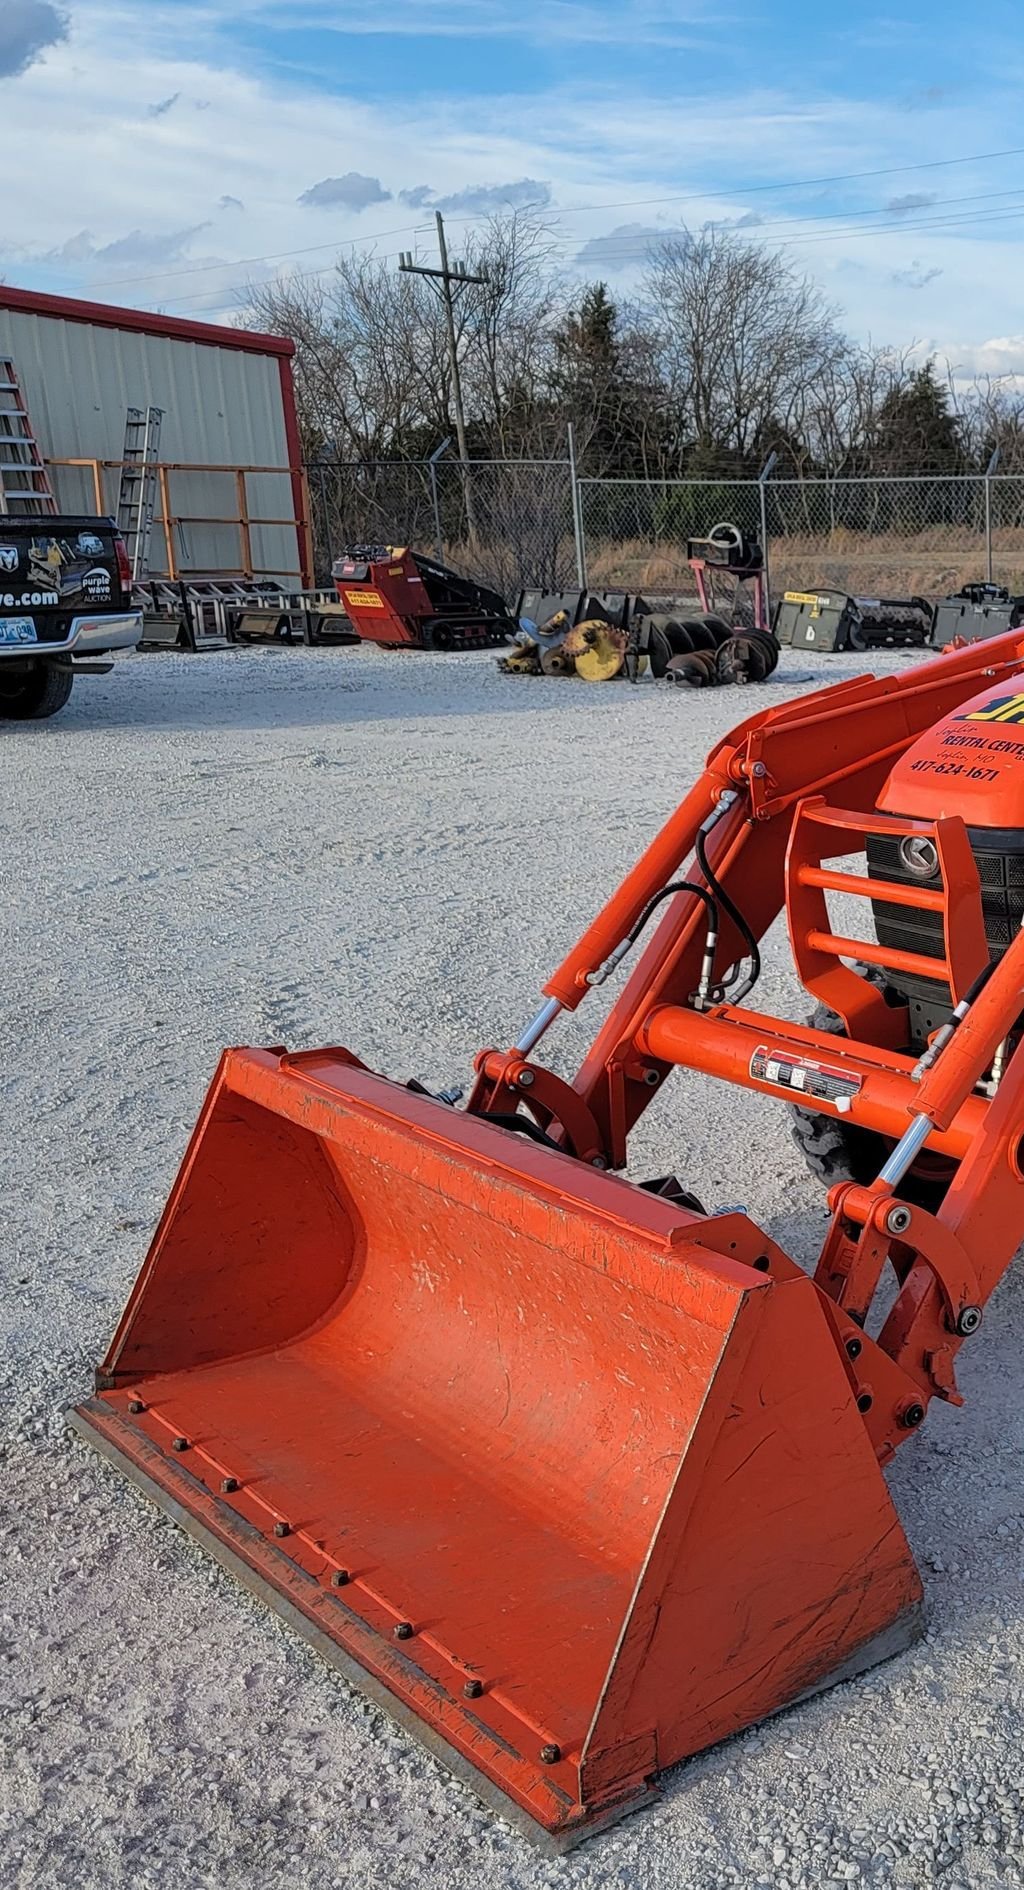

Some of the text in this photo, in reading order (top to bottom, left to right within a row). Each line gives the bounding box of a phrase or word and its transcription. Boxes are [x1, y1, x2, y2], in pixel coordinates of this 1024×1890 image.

[83, 576, 110, 586] purple
[0, 591, 59, 606] e.com
[84, 594, 111, 602] AUCTION
[940, 735, 989, 750] RENTAL
[973, 752, 995, 764] MO
[910, 759, 1000, 782] 417-624-1671
